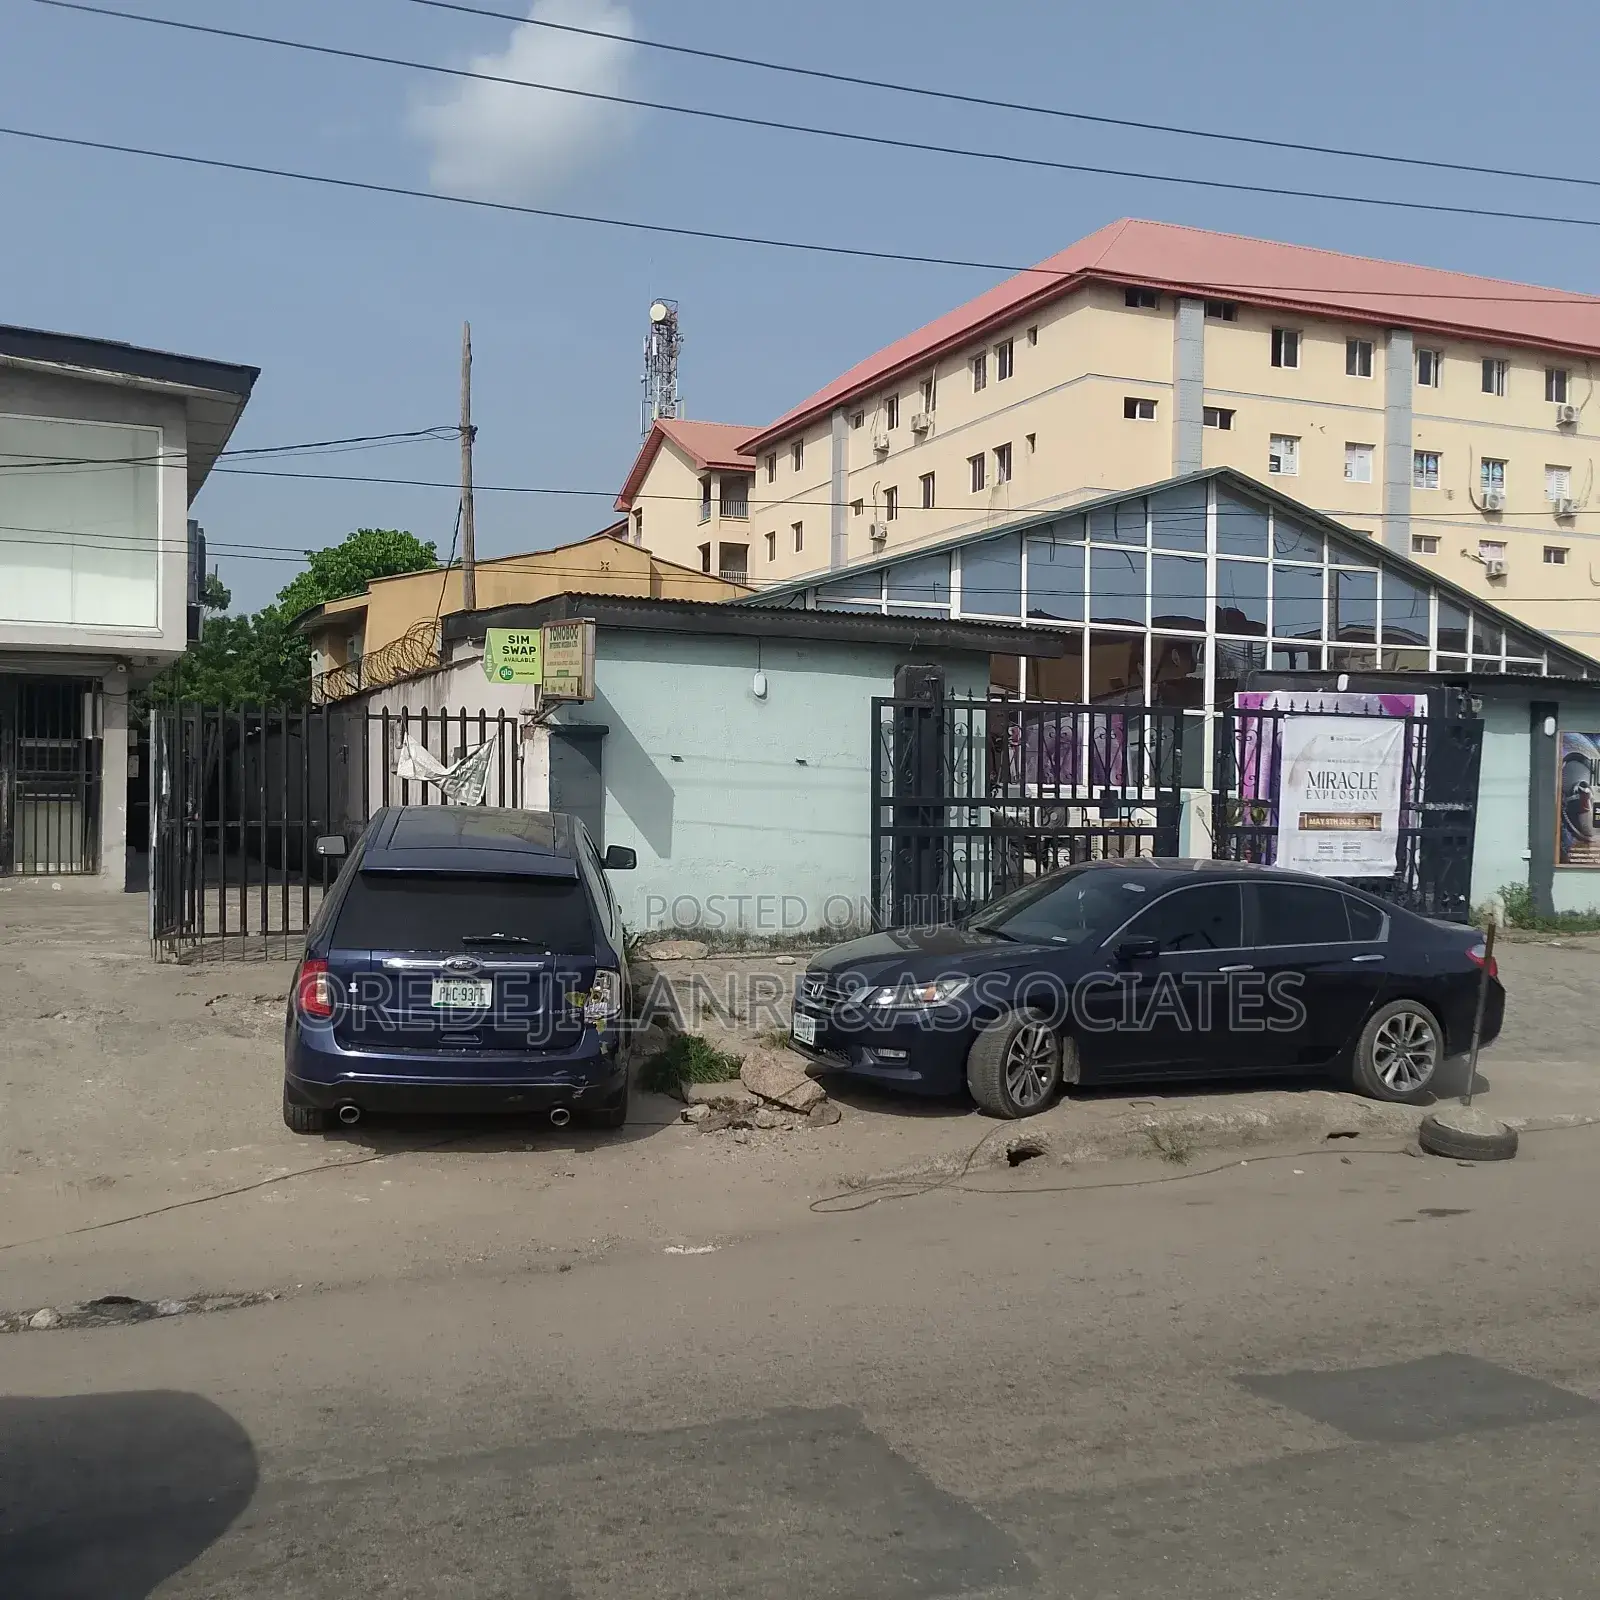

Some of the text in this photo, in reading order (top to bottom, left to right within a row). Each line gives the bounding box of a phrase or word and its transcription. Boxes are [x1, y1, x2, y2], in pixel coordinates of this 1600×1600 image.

[508, 635, 530, 645] SIM
[502, 645, 536, 655] SWAP
[500, 669, 512, 678] glo
[1307, 770, 1379, 790] MIRACLE
[1306, 789, 1378, 801] EXPLOSION
[1308, 818, 1325, 826] MAY
